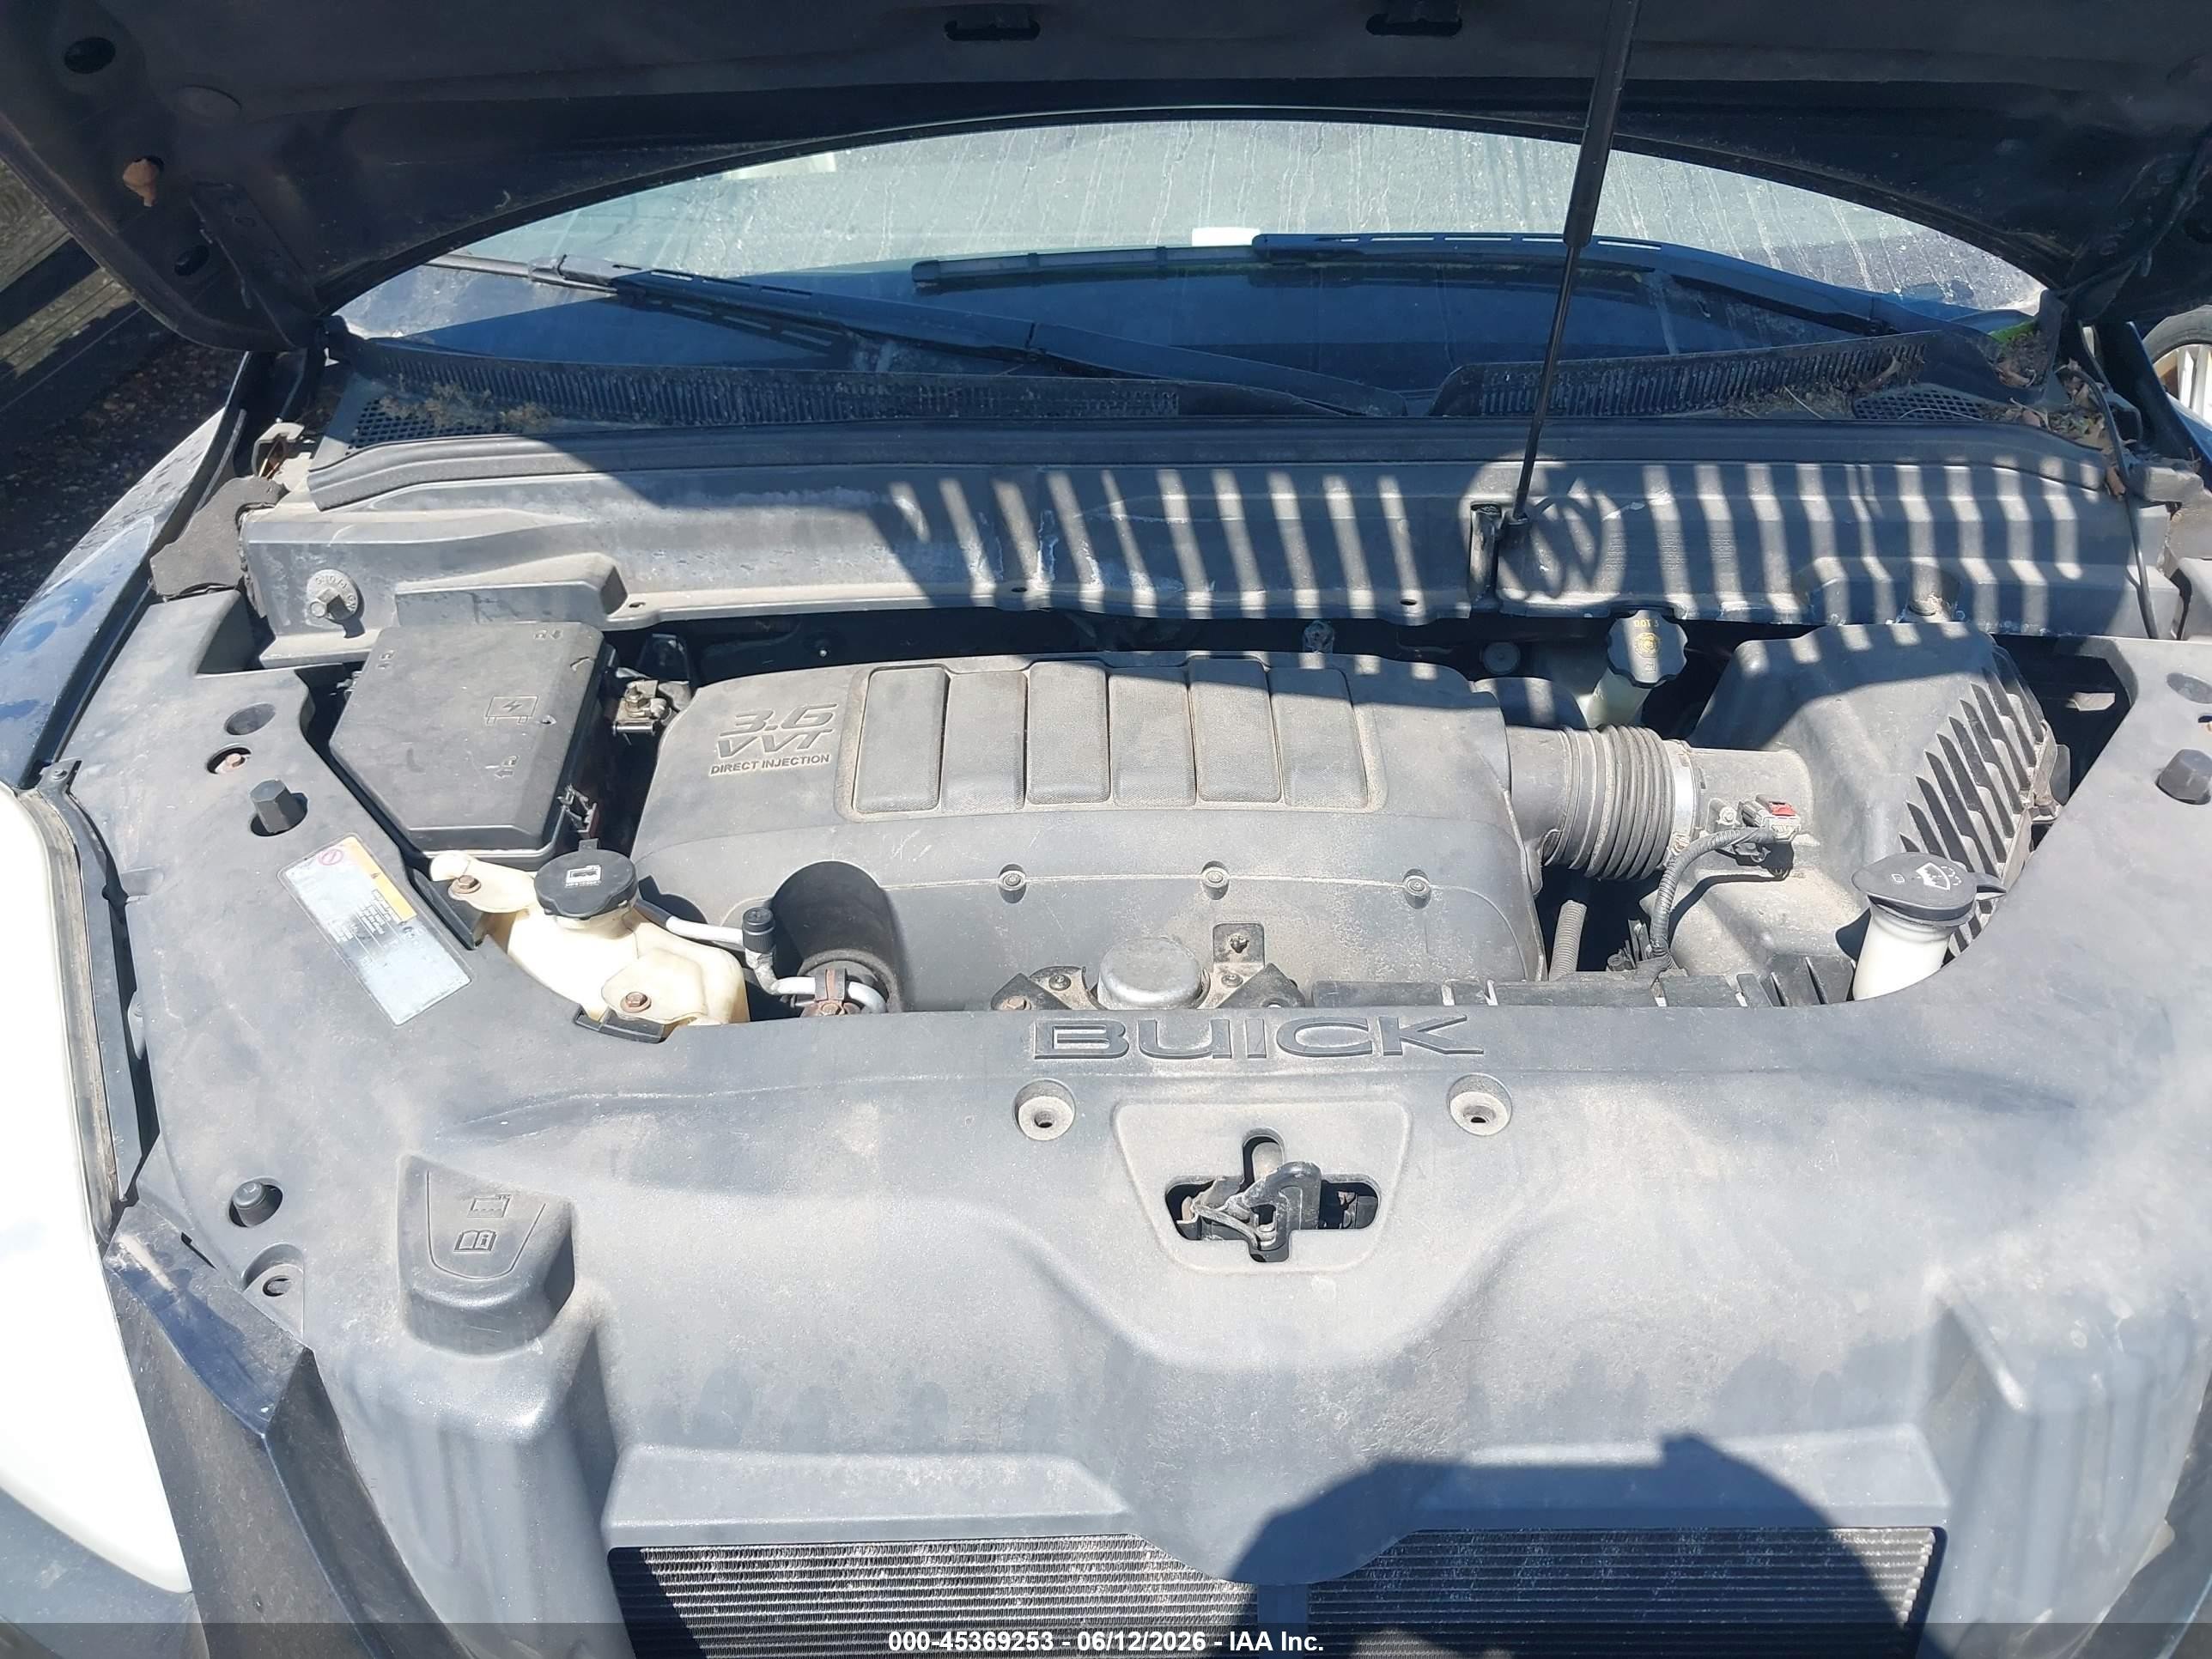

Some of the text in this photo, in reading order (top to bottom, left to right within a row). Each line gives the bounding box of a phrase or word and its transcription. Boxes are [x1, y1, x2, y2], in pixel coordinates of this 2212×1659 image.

[720, 703, 838, 737] 3.6
[717, 728, 834, 758] VVT
[710, 754, 830, 776] DIRECT INJECTION
[1034, 1015, 1485, 1060] BUICK
